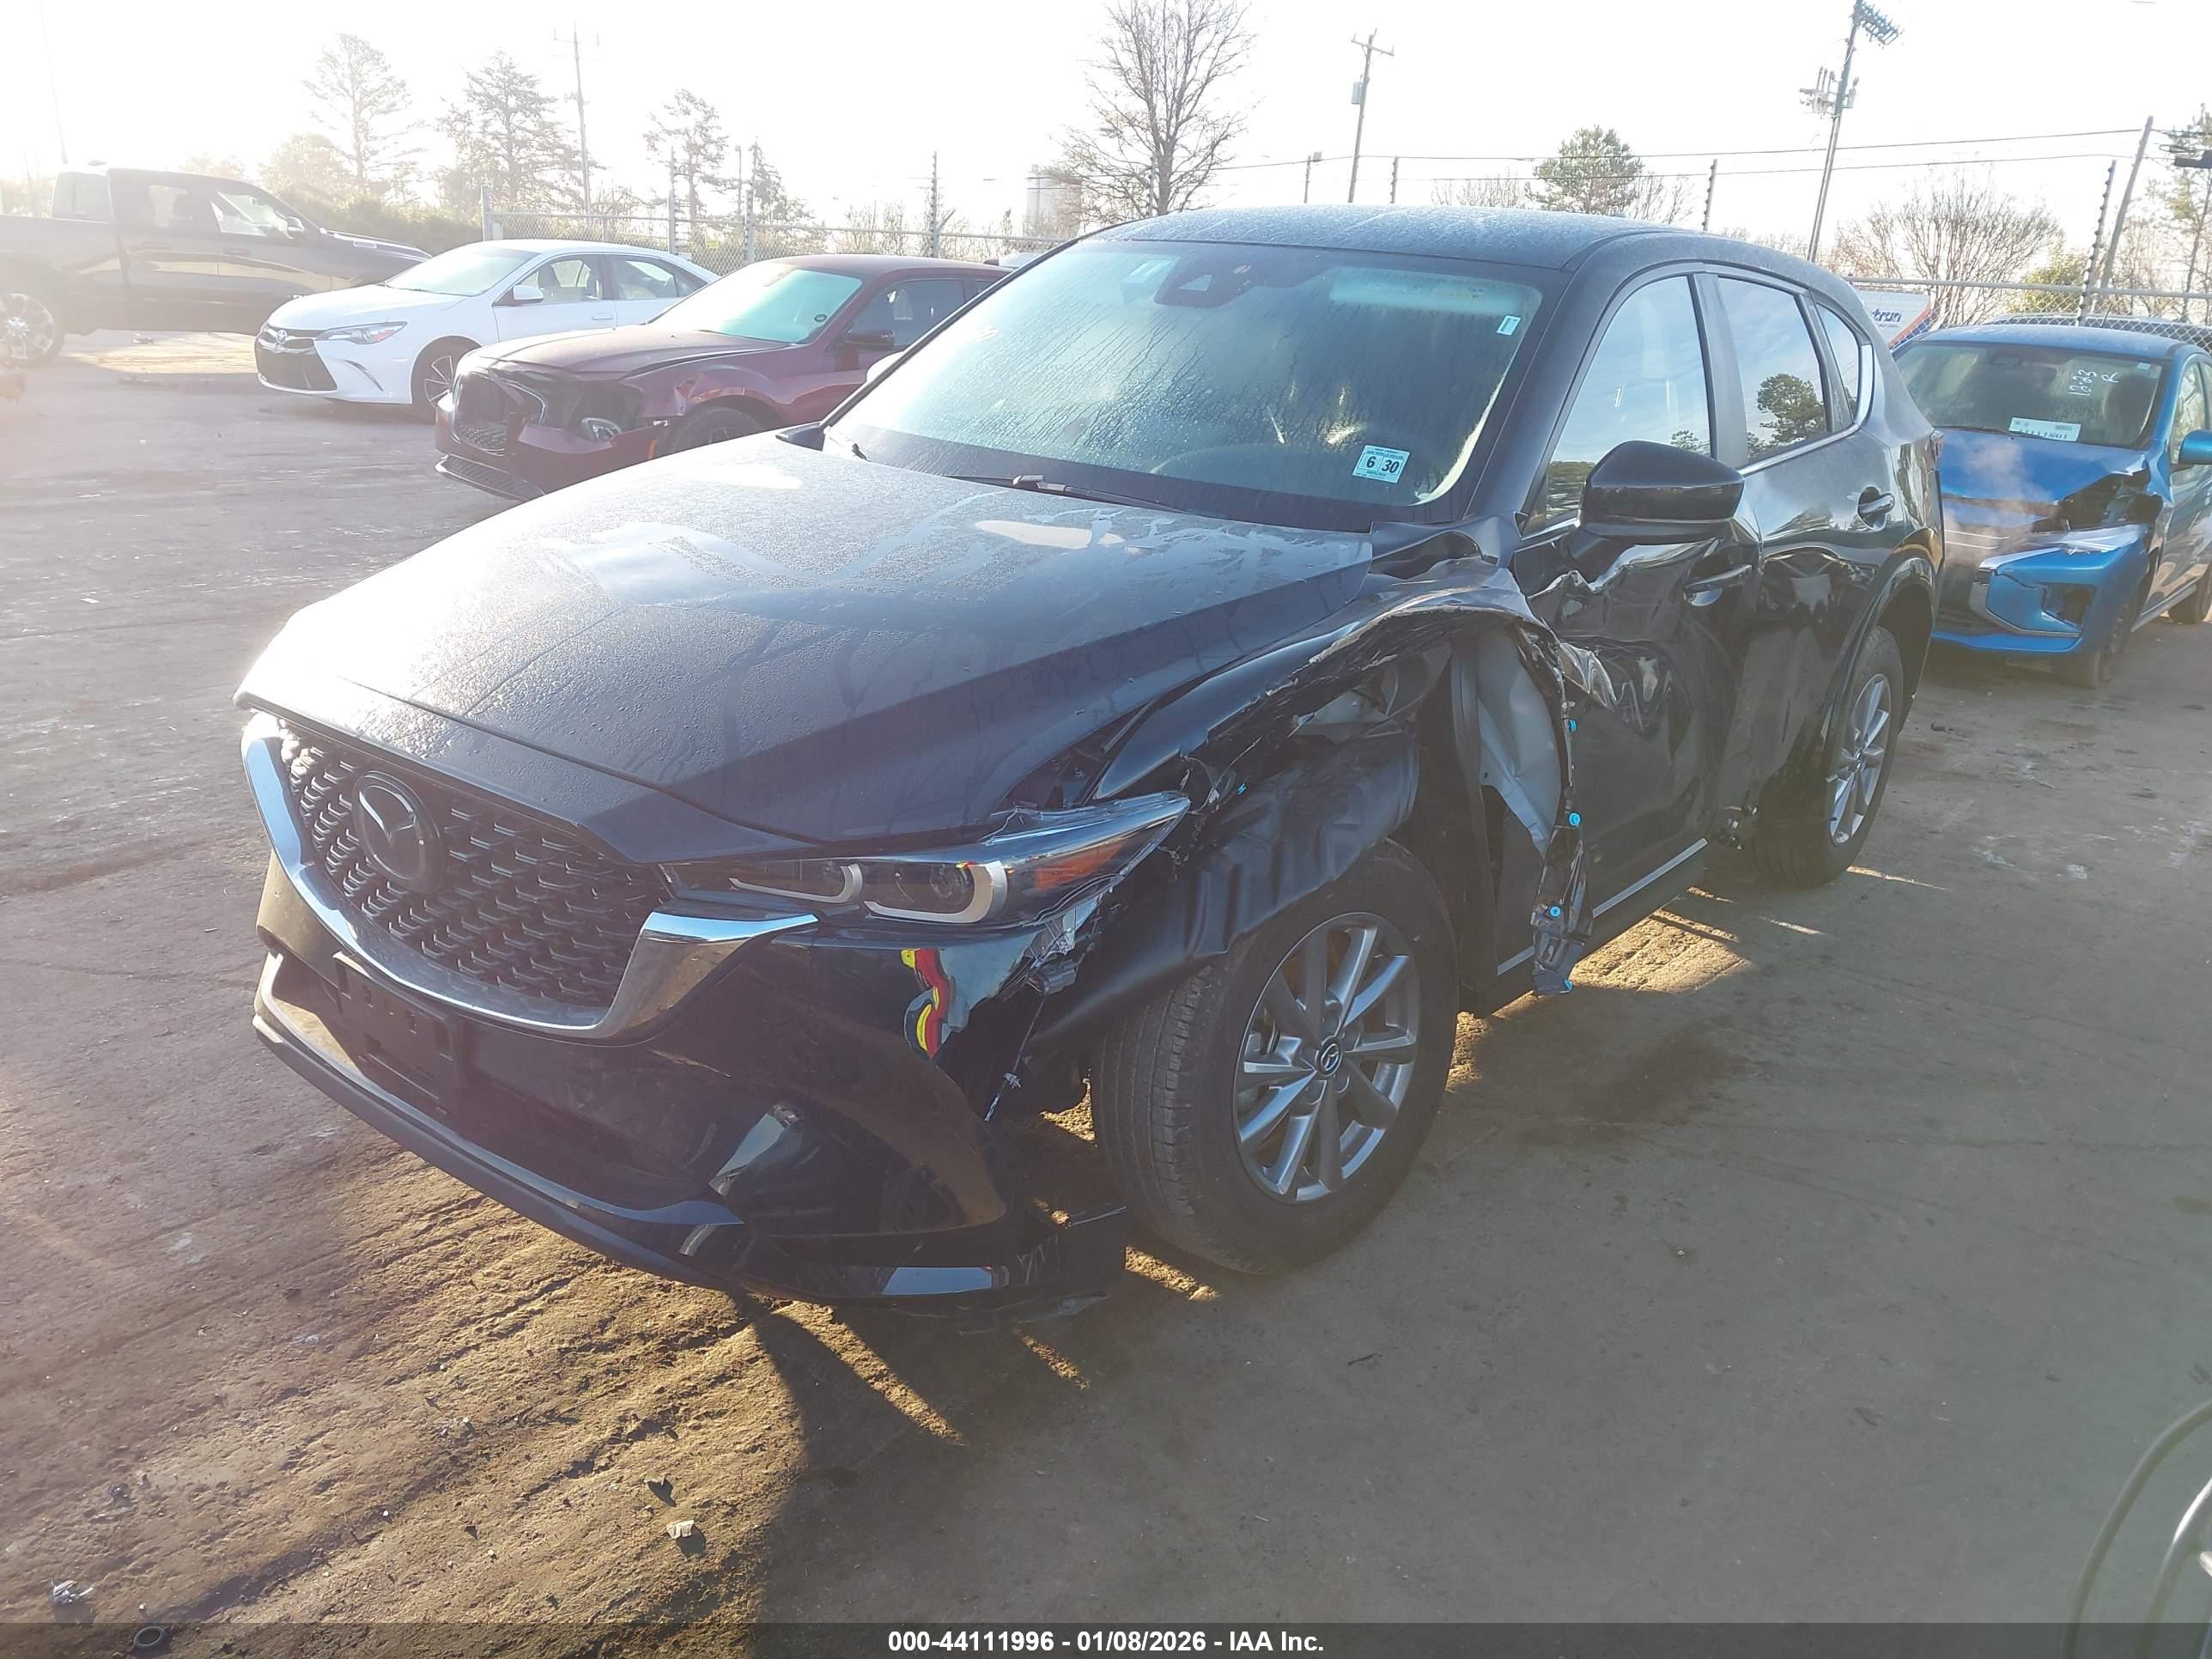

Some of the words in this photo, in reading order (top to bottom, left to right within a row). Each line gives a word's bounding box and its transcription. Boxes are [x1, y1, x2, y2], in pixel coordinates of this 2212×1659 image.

[2101, 372, 2120, 383] R
[1366, 456, 1376, 468] 6
[1381, 459, 1400, 474] 30
